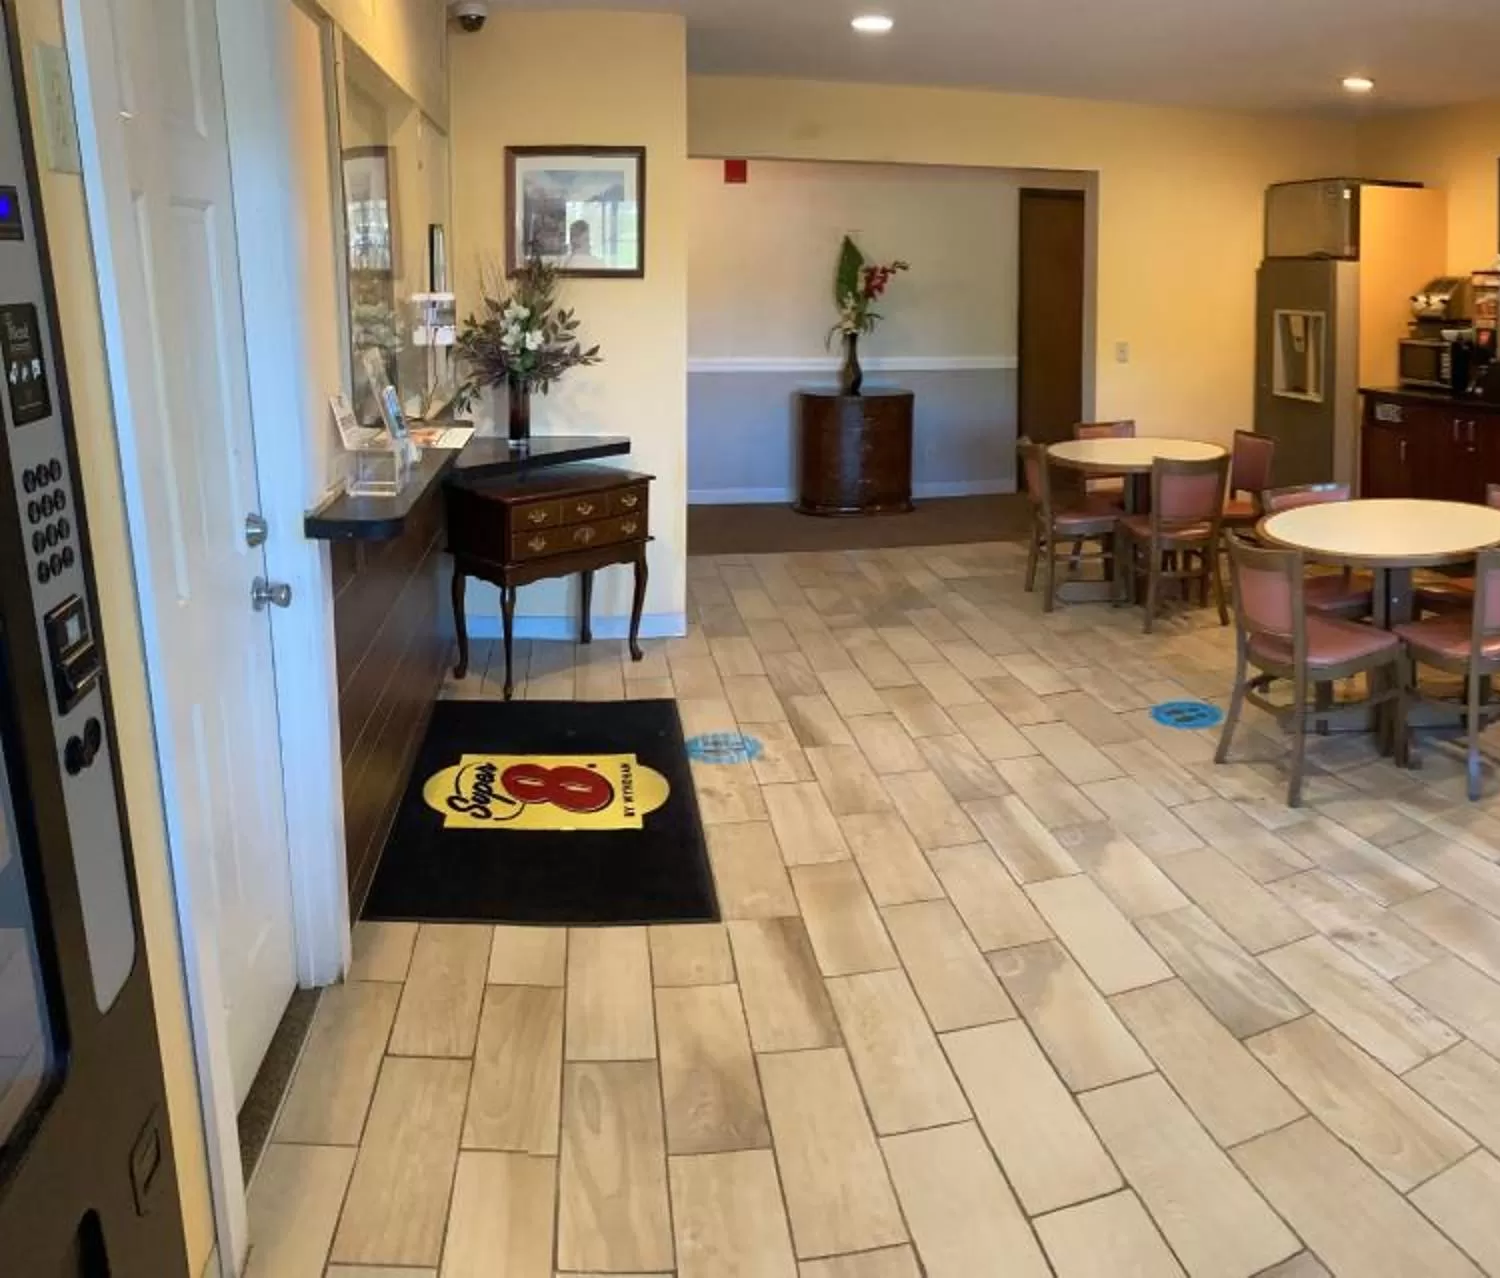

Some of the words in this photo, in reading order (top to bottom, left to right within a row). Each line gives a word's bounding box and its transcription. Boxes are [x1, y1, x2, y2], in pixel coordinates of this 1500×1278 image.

[446, 762, 516, 820] Super
[500, 763, 615, 814] 8
[623, 807, 635, 817] BY
